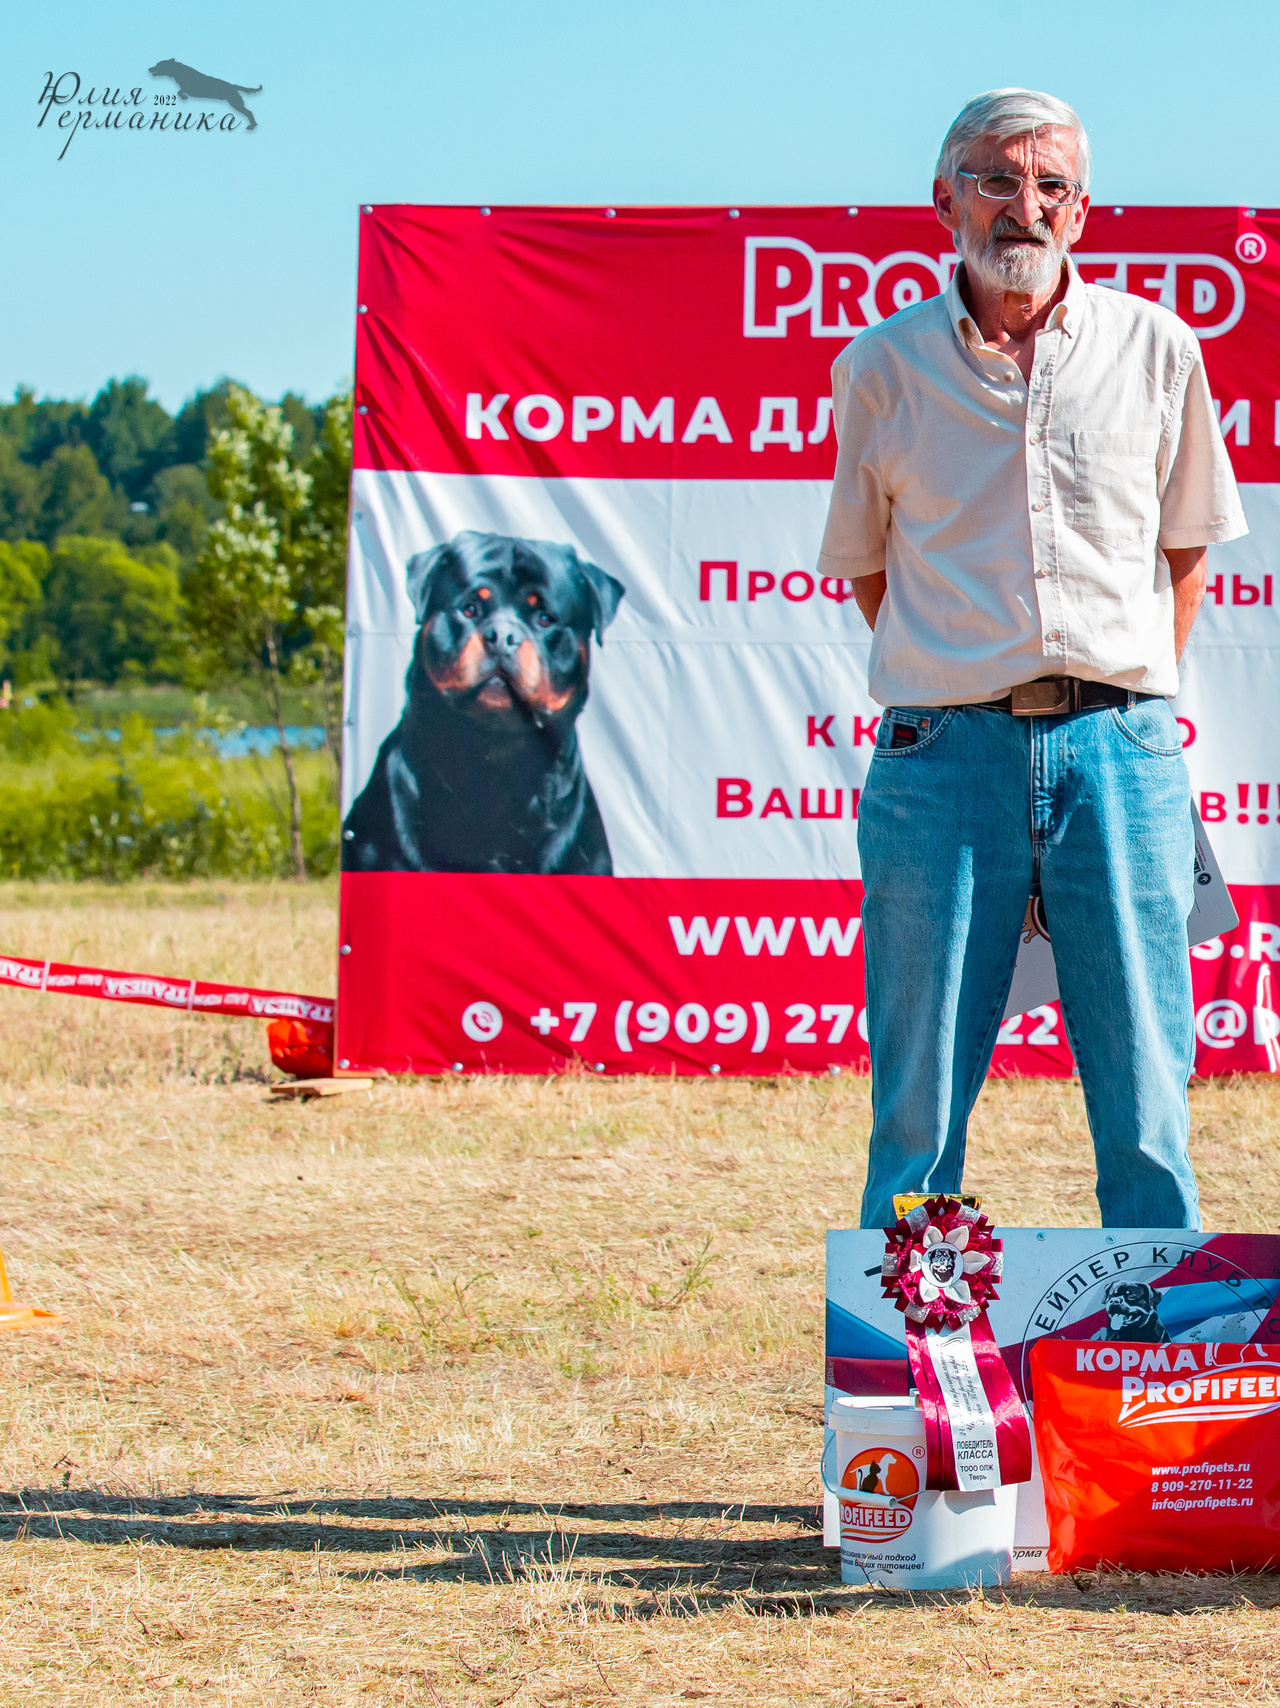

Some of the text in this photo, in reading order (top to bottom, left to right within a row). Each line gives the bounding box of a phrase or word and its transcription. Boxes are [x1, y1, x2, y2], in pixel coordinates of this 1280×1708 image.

[465, 392, 733, 443] КОРМА
[749, 396, 834, 452] ДЛ
[700, 561, 855, 603] ПРОФ
[806, 715, 836, 748] К
[853, 715, 882, 748] К
[716, 777, 861, 820] ВАШ
[668, 915, 862, 957] WWW
[105, 977, 187, 1004] ТРАПЕЗА
[251, 997, 332, 1023] ТРАПЕЗА
[530, 1002, 597, 1042] +7
[614, 1000, 770, 1053] (909)
[785, 1004, 870, 1045] 27
[1035, 1251, 1130, 1332] ЕЙЛЕР
[1152, 1246, 1245, 1289] КЛУБ
[1076, 1347, 1199, 1372] КОРМА
[957, 1439, 994, 1450] ПОБЕДИТЕЛЬ
[957, 1449, 994, 1460] КЛАССА
[1151, 1462, 1251, 1477] www.profipets.ru
[1151, 1478, 1253, 1493] 8 909-270-11-22
[840, 1504, 912, 1528] ROFIFEED
[1151, 1497, 1254, 1511] info@profipets.ru
[877, 1561, 925, 1571] питомцев!
[885, 1553, 917, 1562] подход
